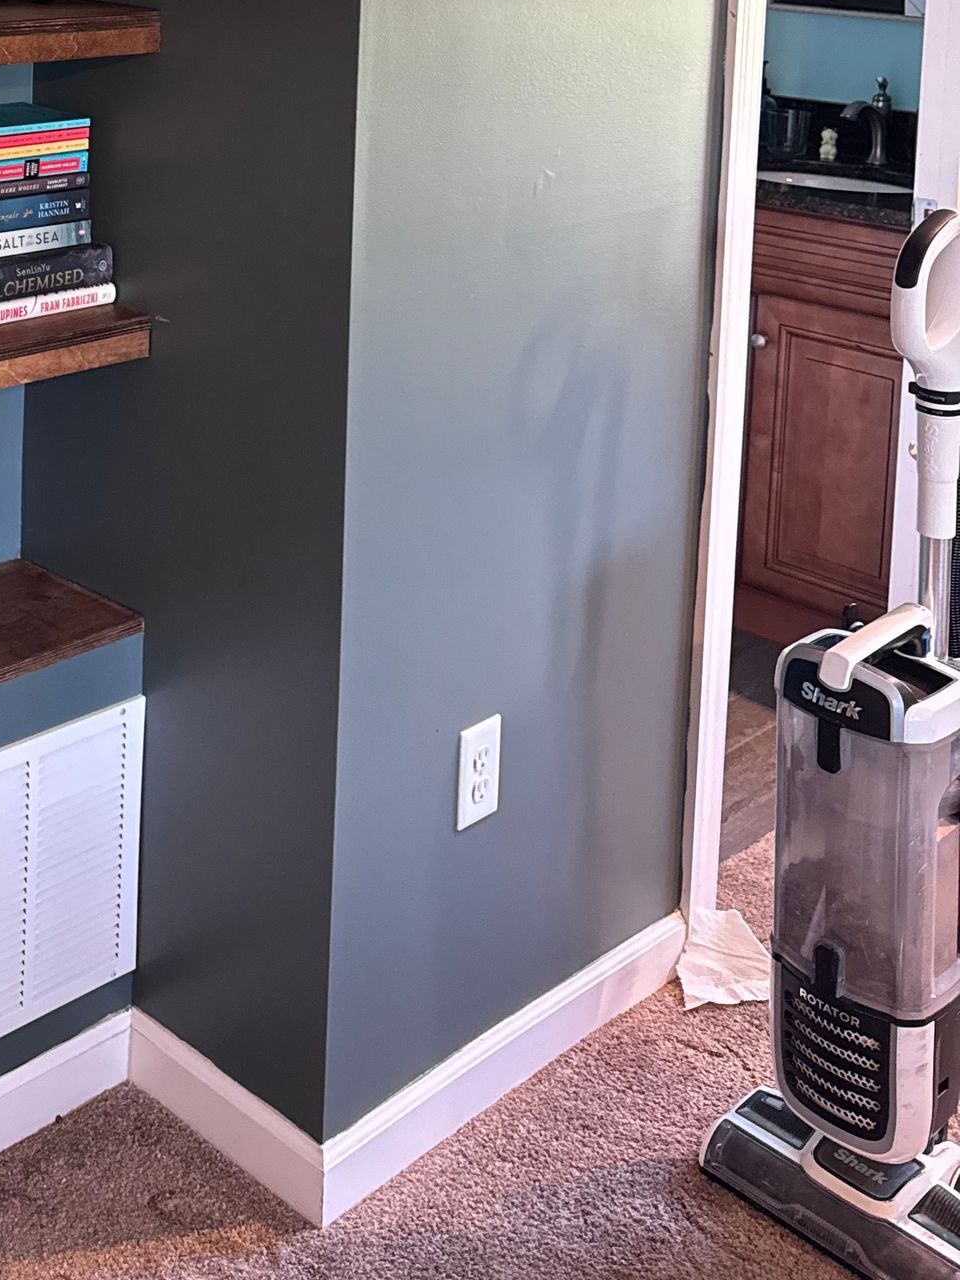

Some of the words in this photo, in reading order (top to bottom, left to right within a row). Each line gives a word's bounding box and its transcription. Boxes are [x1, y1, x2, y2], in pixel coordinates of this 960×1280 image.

[0, 186, 16, 194] WERE
[18, 184, 40, 192] WOLVES
[39, 199, 69, 210] KRISTIN
[38, 207, 70, 218] HANNAH
[35, 230, 60, 245] SEA
[16, 264, 51, 277] SenLinYu
[40, 299, 60, 313] FRAN
[62, 292, 98, 309] FABRICZKI
[801, 681, 863, 720] Shark
[799, 987, 861, 1028] ROTATOR
[833, 1148, 889, 1185] Shark
